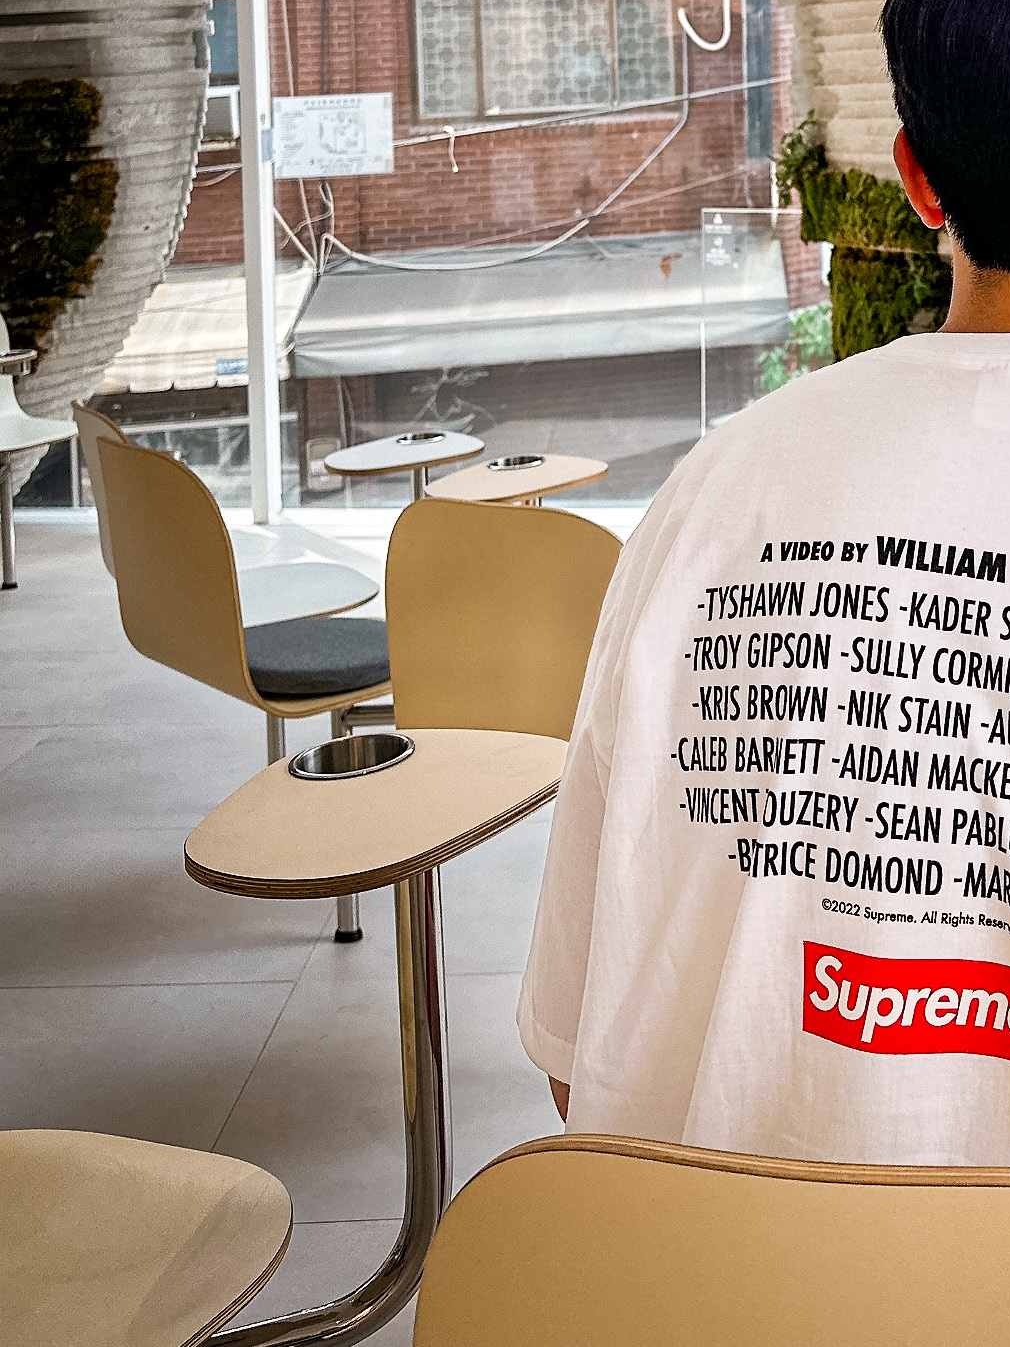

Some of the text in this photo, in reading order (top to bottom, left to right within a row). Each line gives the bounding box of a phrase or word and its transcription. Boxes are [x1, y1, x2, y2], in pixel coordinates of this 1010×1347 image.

[759, 542, 773, 563] A
[780, 540, 835, 562] VIDEO
[840, 541, 870, 564] BY
[876, 535, 1007, 584] WILLIAM
[697, 581, 806, 622] -TYSHAWN
[809, 582, 891, 623] JONES
[898, 591, 992, 638] -KADER
[684, 634, 742, 672] -TROY
[747, 632, 832, 670] GIPSON
[840, 636, 927, 680] -SULLY
[692, 685, 741, 722] -KRIS
[746, 684, 829, 723] BROWN
[837, 689, 892, 731] -NIK
[897, 695, 972, 740] STAIN
[670, 736, 728, 772] -CALEB
[831, 742, 920, 788] -AIDAN
[679, 787, 761, 825] -VINCENT
[864, 801, 942, 844] -SEAN
[825, 846, 943, 896] DOMOND
[821, 898, 861, 917] ©2022
[863, 906, 917, 925] Supreme.
[920, 910, 938, 924] All
[940, 911, 975, 928] Rights
